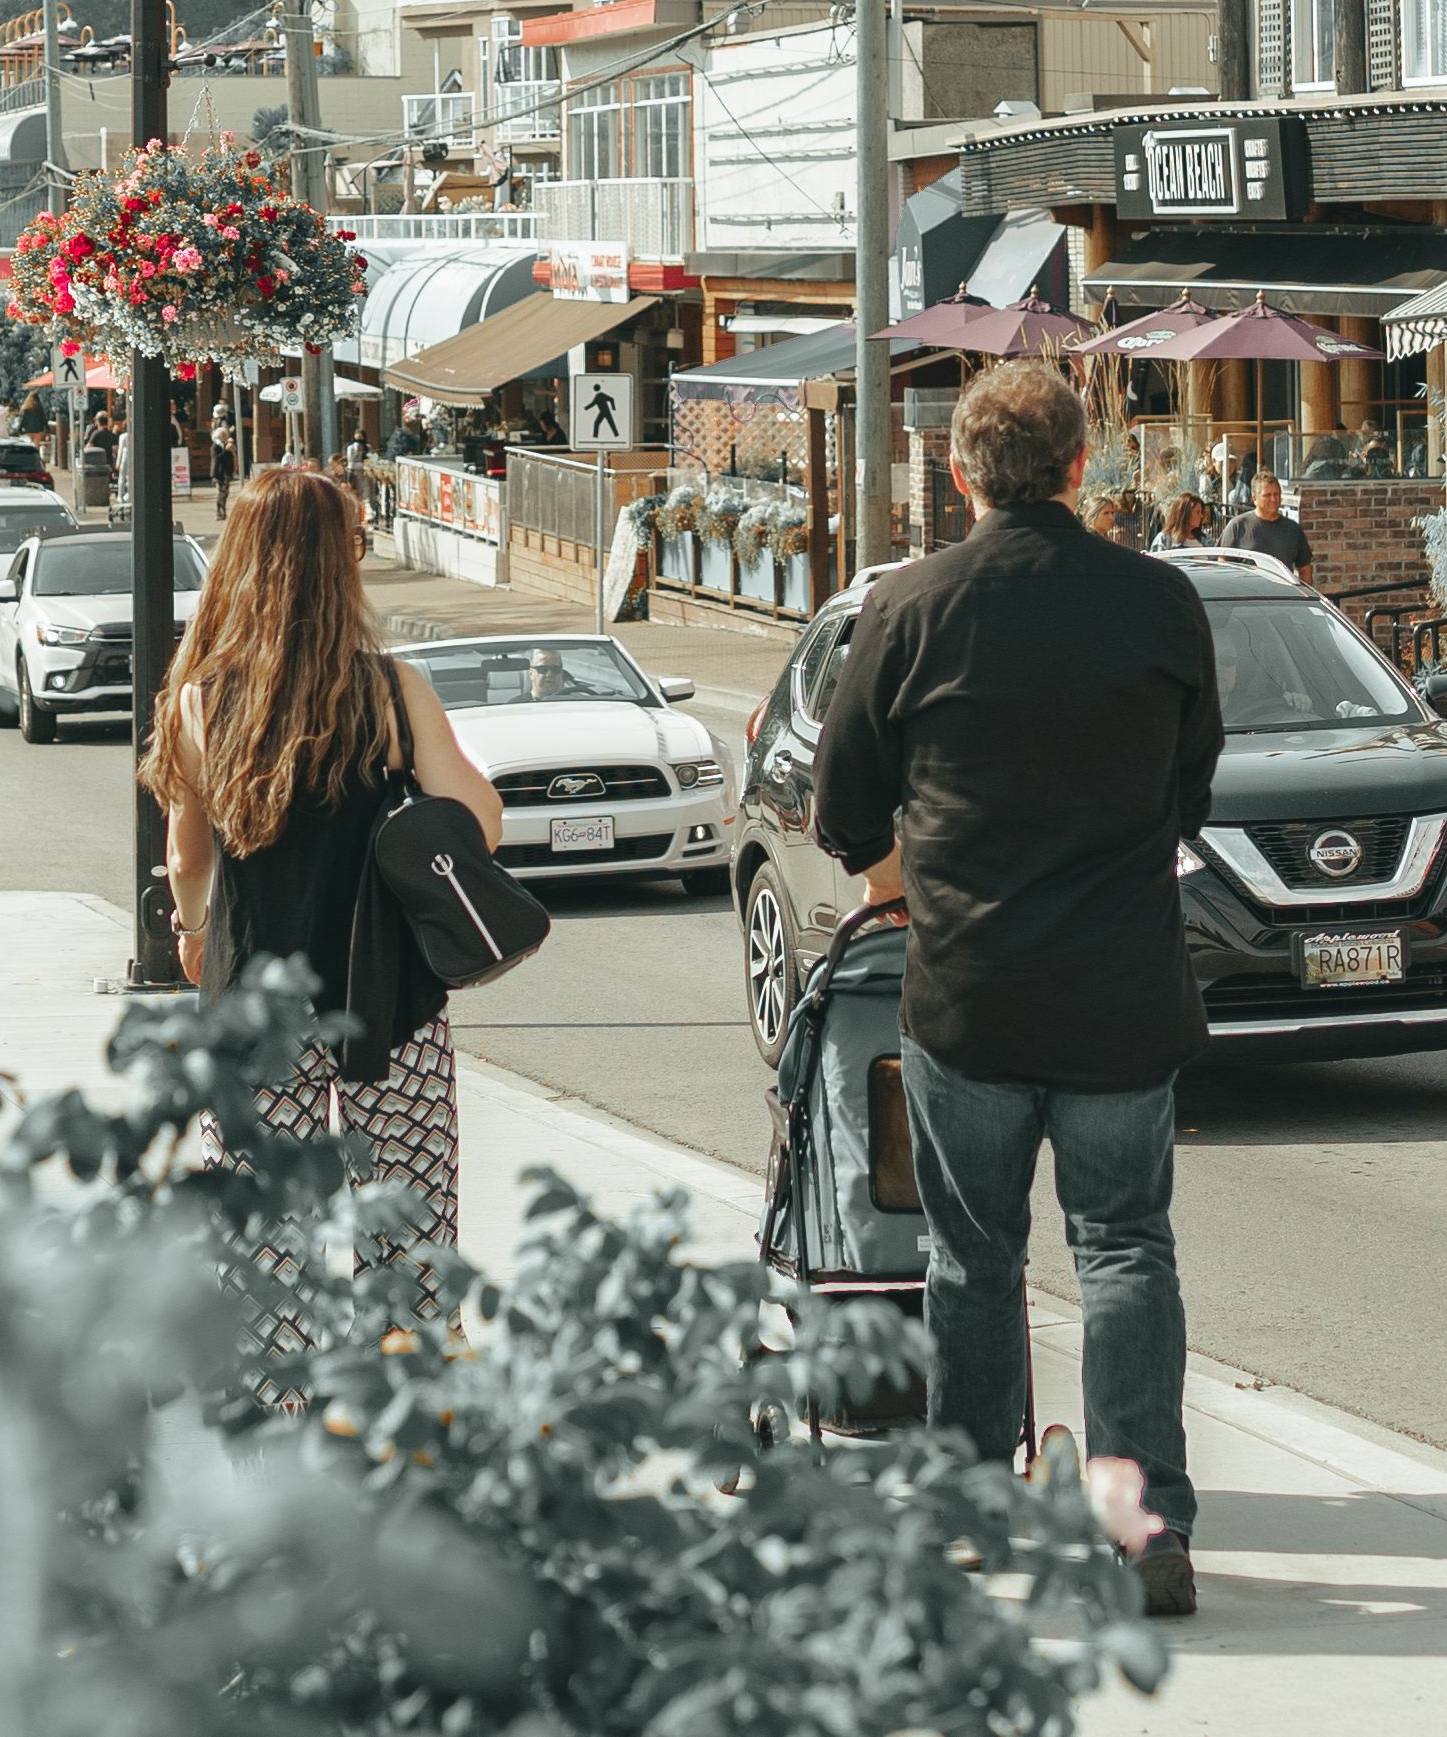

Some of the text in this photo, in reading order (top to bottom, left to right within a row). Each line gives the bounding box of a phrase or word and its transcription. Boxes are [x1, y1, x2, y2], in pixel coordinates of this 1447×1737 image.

[1147, 142, 1226, 201] OCEAN BEACH
[1316, 848, 1357, 858] NISSAN
[1303, 929, 1401, 945] Applewood
[1319, 944, 1401, 974] RA871R
